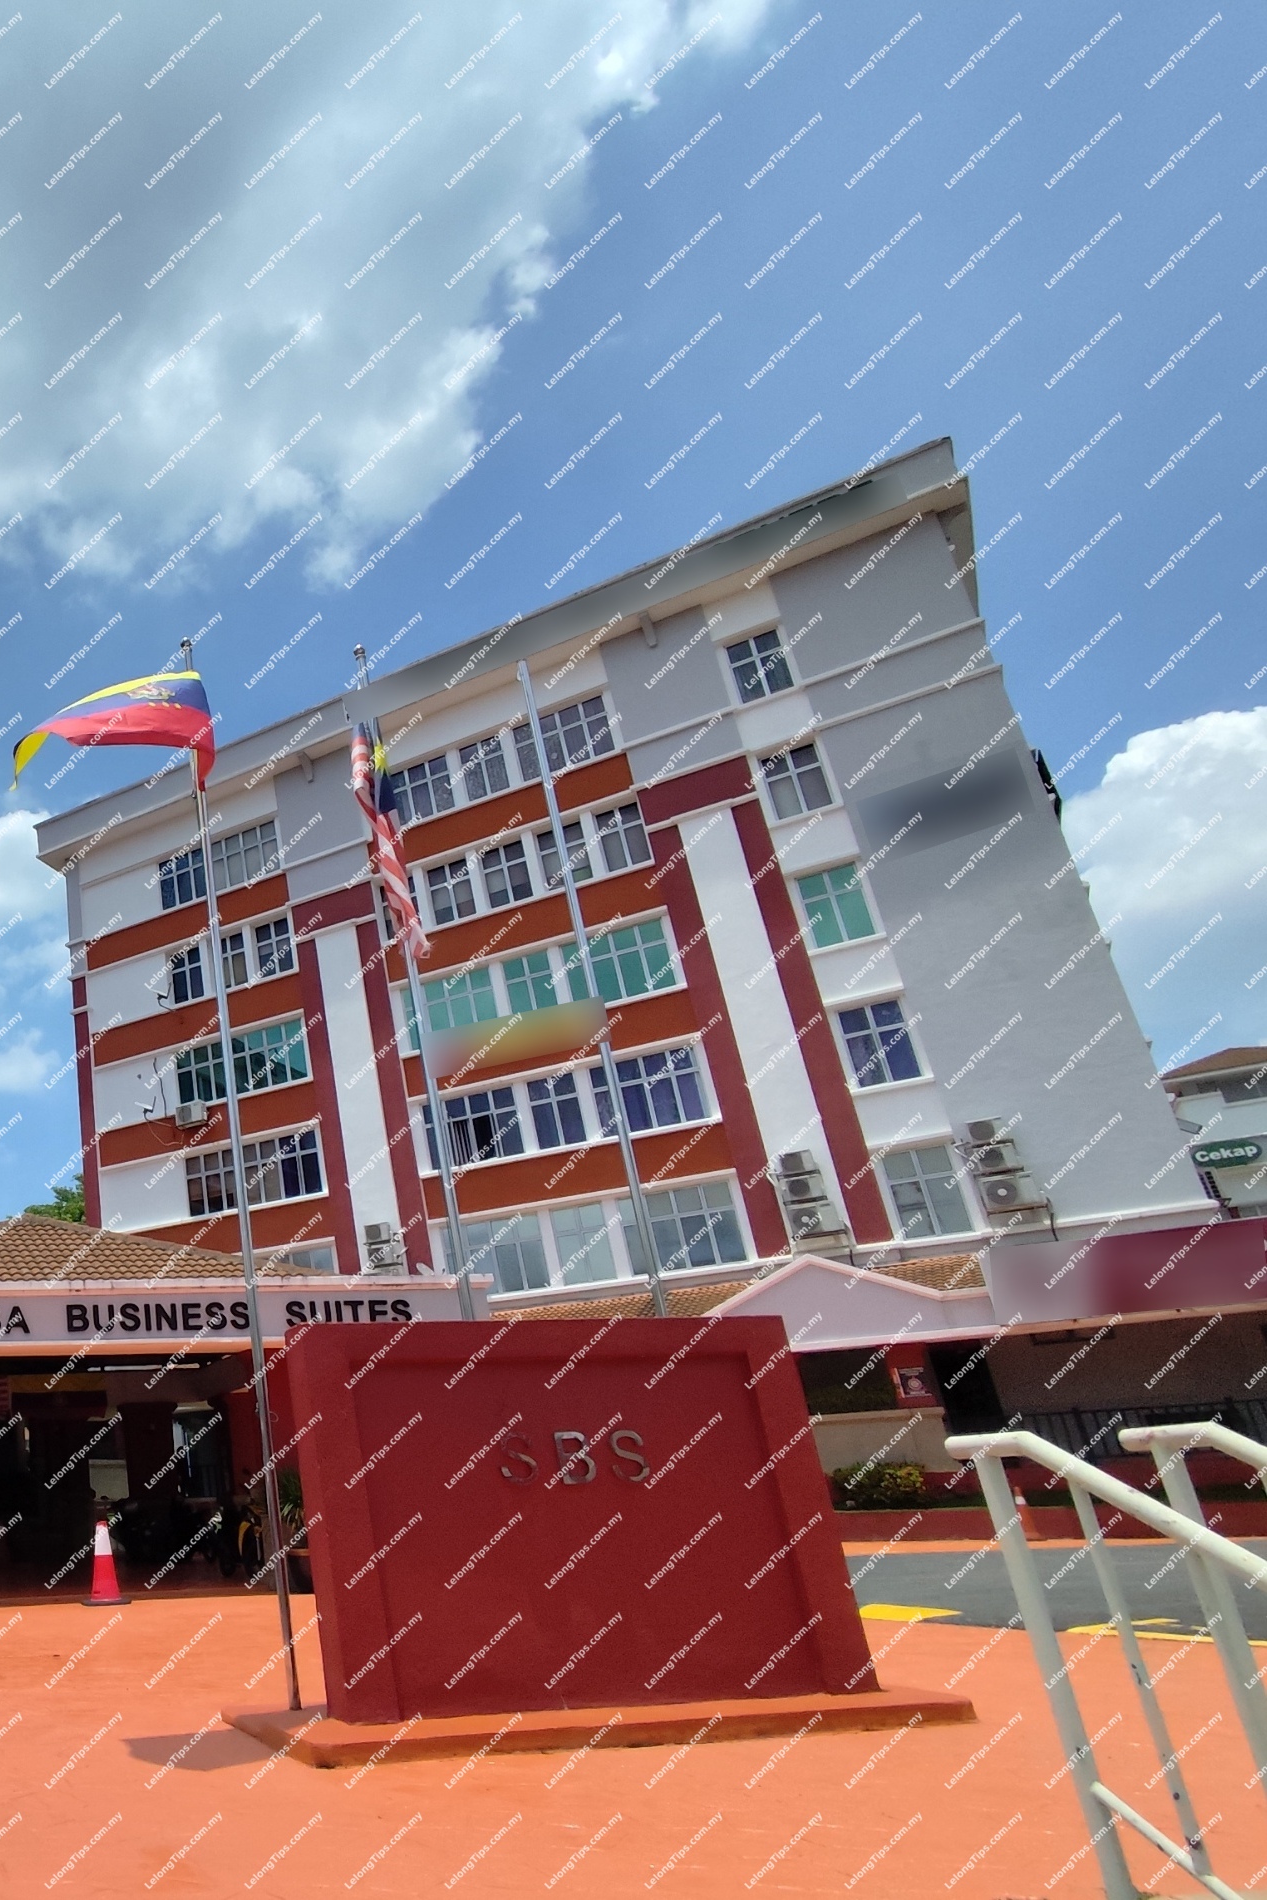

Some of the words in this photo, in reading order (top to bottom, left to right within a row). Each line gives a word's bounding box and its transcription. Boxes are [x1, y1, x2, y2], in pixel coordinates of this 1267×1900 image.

[1194, 1145, 1258, 1163] Cekap
[66, 1302, 250, 1332] BUSINESS
[285, 1299, 413, 1327] SUITES
[500, 1429, 651, 1486] SBS
